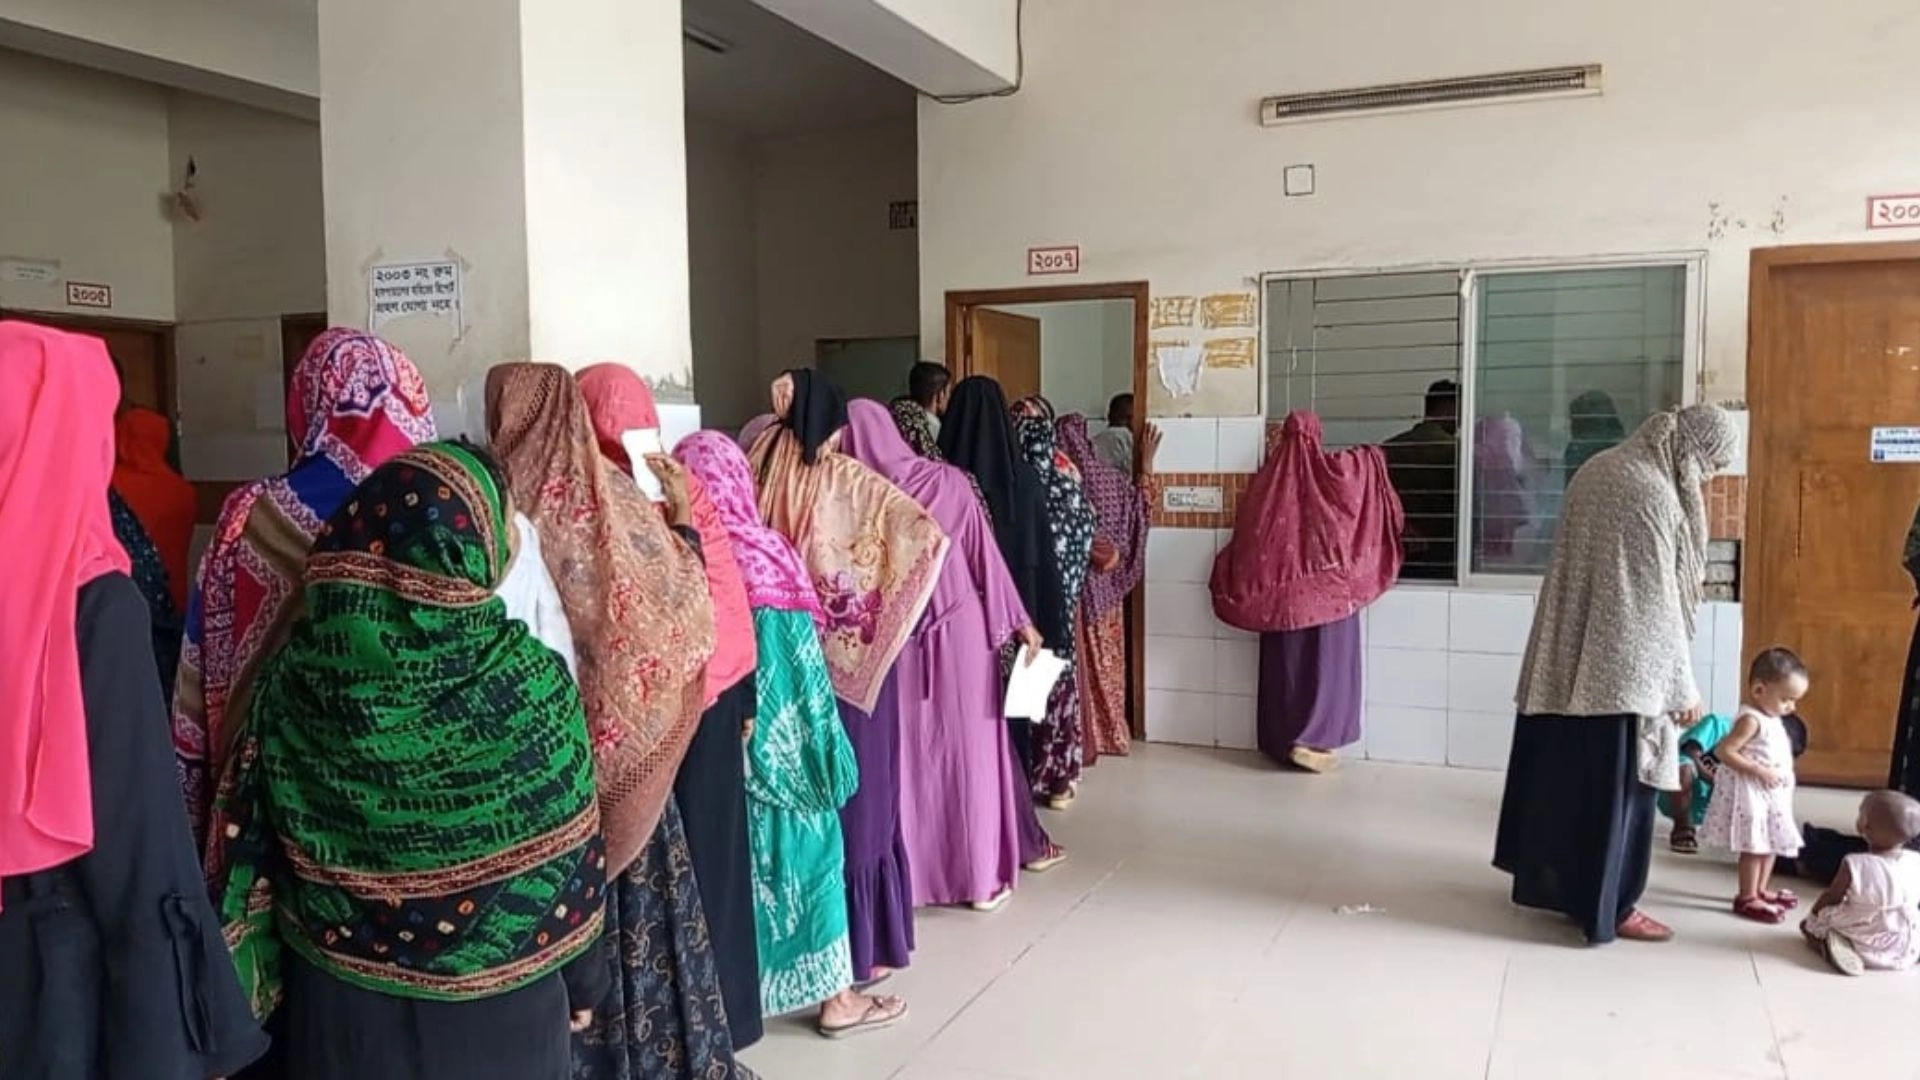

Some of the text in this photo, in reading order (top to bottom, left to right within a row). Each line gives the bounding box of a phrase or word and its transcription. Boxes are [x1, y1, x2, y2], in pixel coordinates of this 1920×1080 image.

[1035, 252, 1073, 270] ২০০৭
[376, 269, 411, 282] ২০০৩
[414, 267, 429, 279] নং
